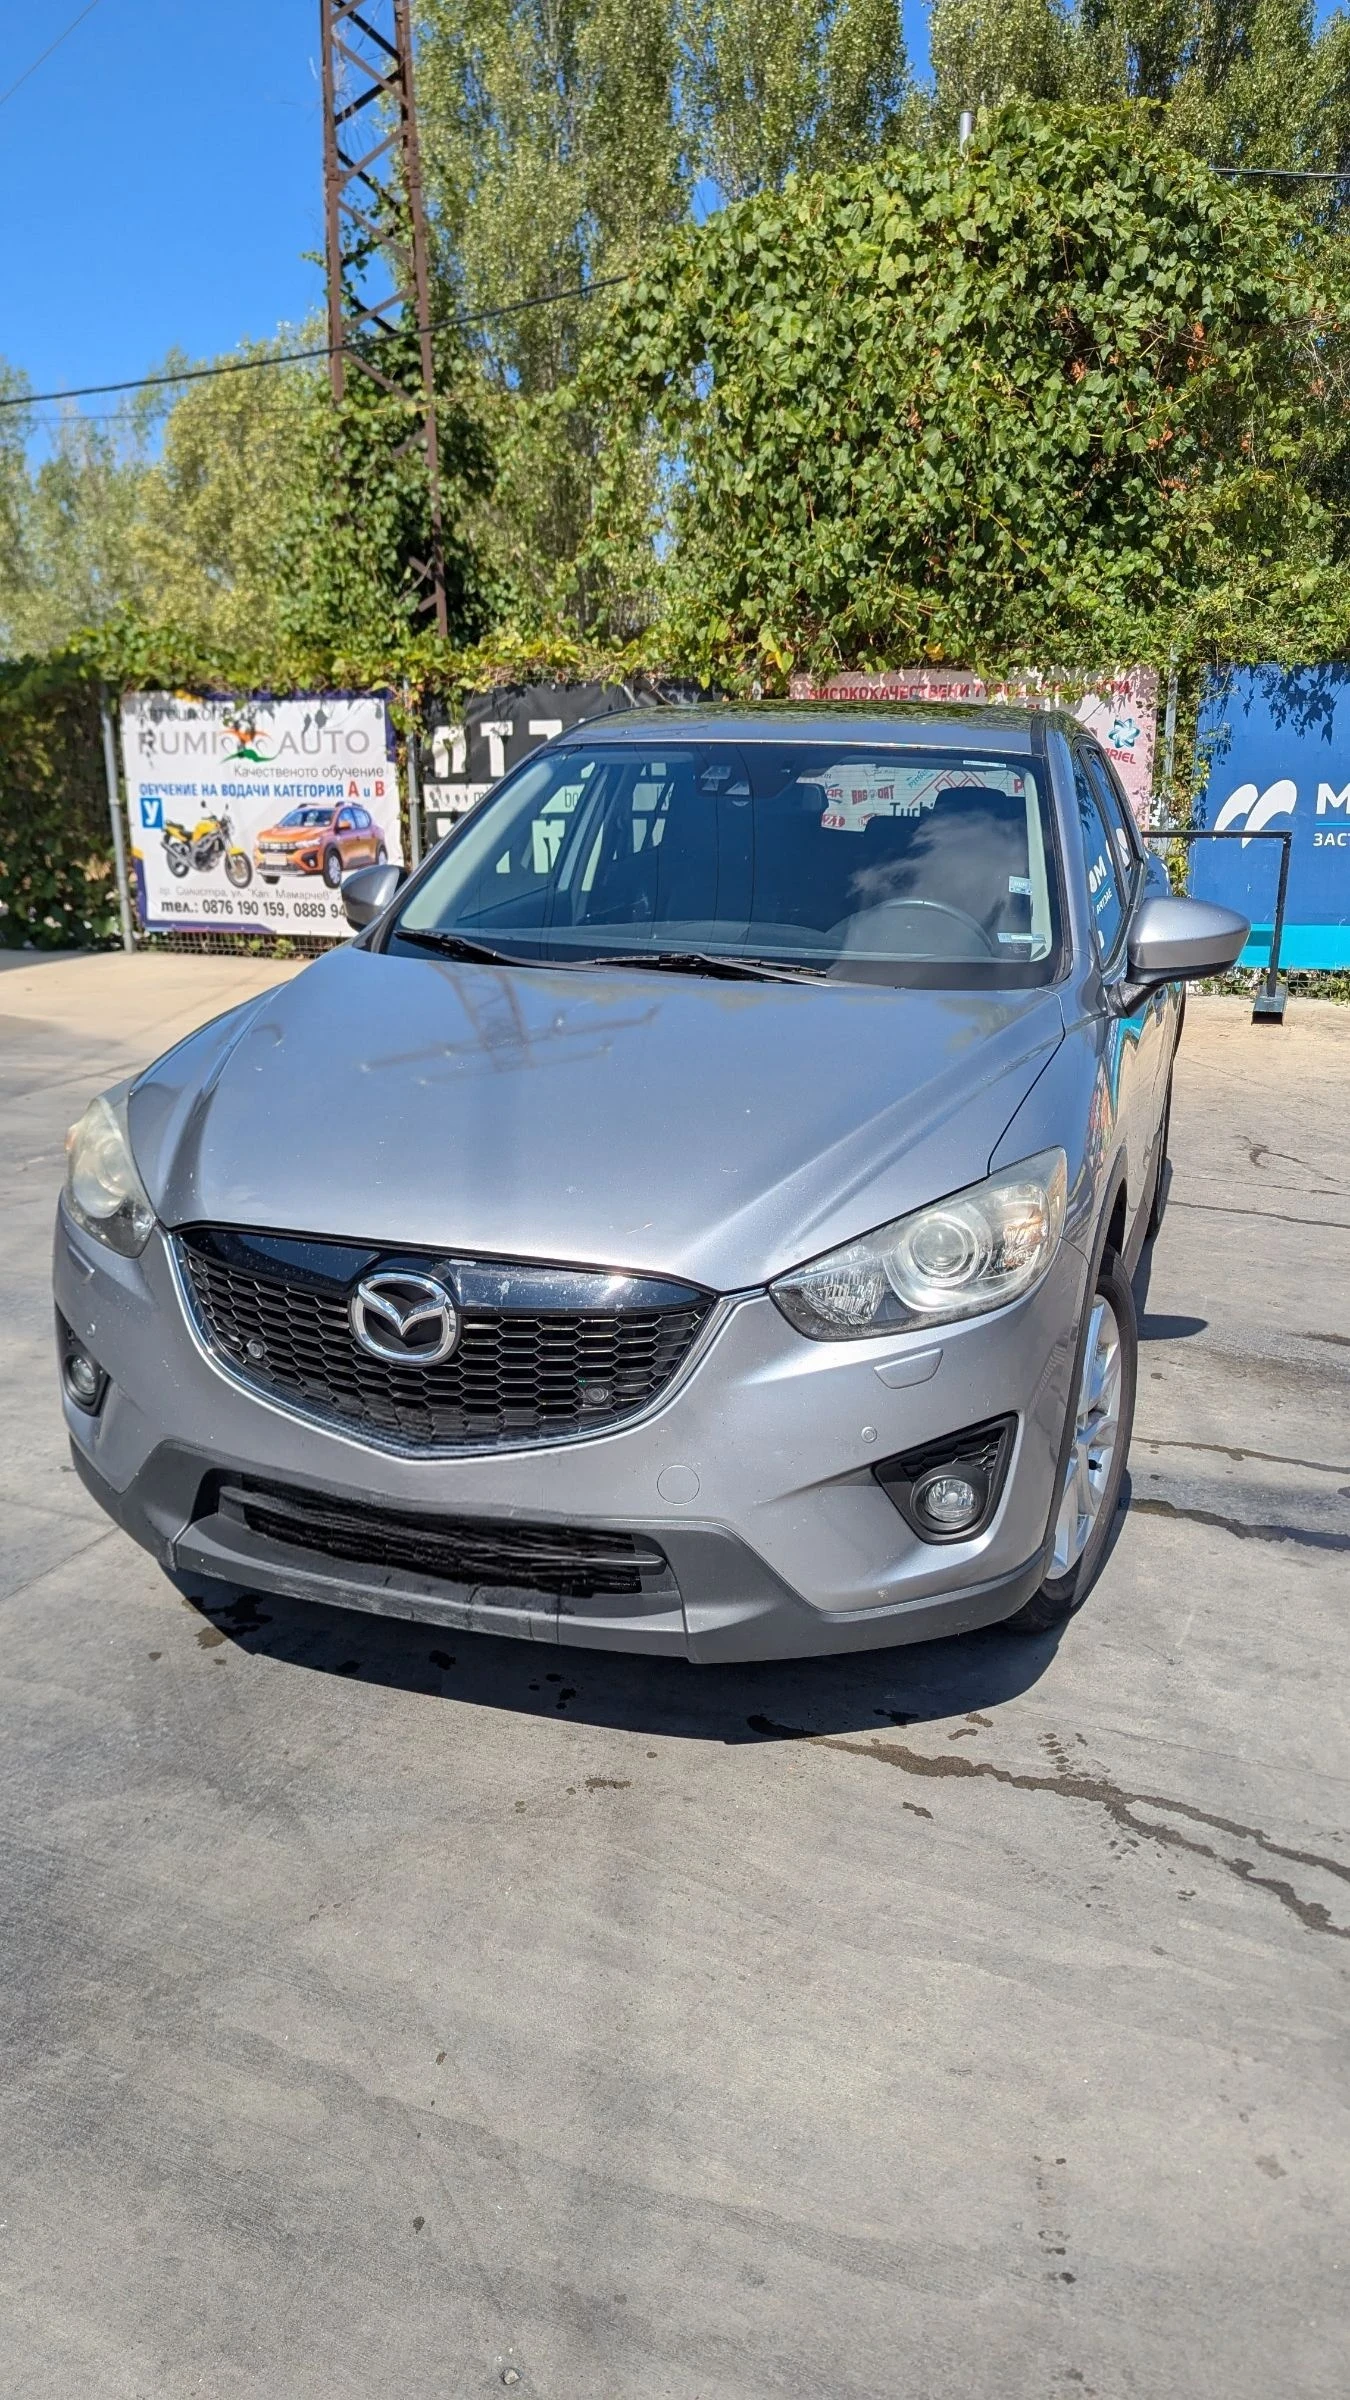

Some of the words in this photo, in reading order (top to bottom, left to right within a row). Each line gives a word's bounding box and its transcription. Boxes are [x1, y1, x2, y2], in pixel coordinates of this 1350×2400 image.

[138, 731, 217, 755] RUMI
[279, 730, 370, 755] AUTO
[234, 766, 318, 778] Качественото
[322, 764, 384, 780] обучение
[139, 784, 198, 796] ОБУЧЕНИЕ
[202, 784, 218, 797] НА
[222, 784, 270, 798] ВОДАЧИ
[273, 784, 344, 797] КАТЕГОРИЯ
[1313, 832, 1350, 847] ЗАС
[202, 899, 234, 914] 0876
[237, 901, 259, 916] 190
[263, 902, 289, 918] 159,
[294, 903, 326, 918] 0889
